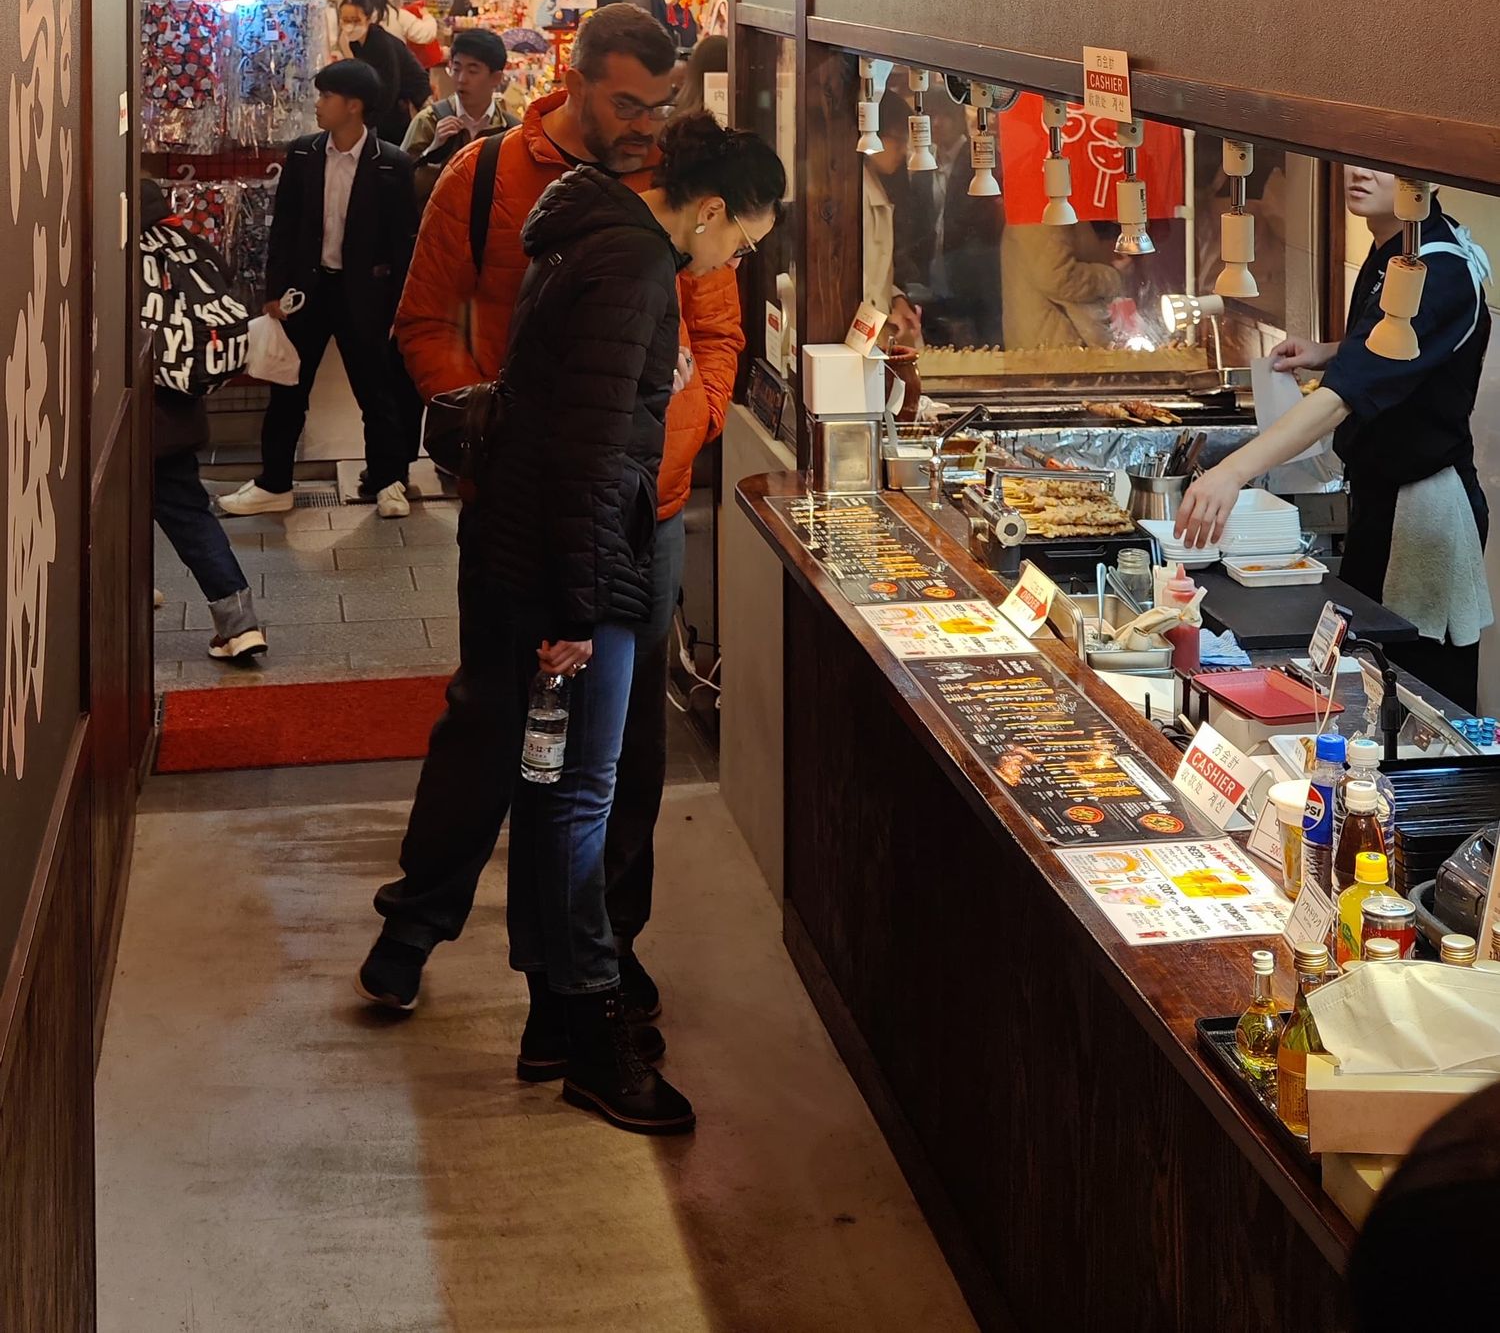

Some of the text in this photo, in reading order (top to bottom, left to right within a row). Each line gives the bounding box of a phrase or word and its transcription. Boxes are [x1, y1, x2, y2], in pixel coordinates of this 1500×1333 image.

[1089, 73, 1123, 93] CASHIER
[205, 333, 248, 375] CIT
[1020, 591, 1040, 611] ORDER
[1212, 743, 1240, 770] お会計
[1191, 752, 1236, 797] CASHIER
[1304, 803, 1322, 818] PSI
